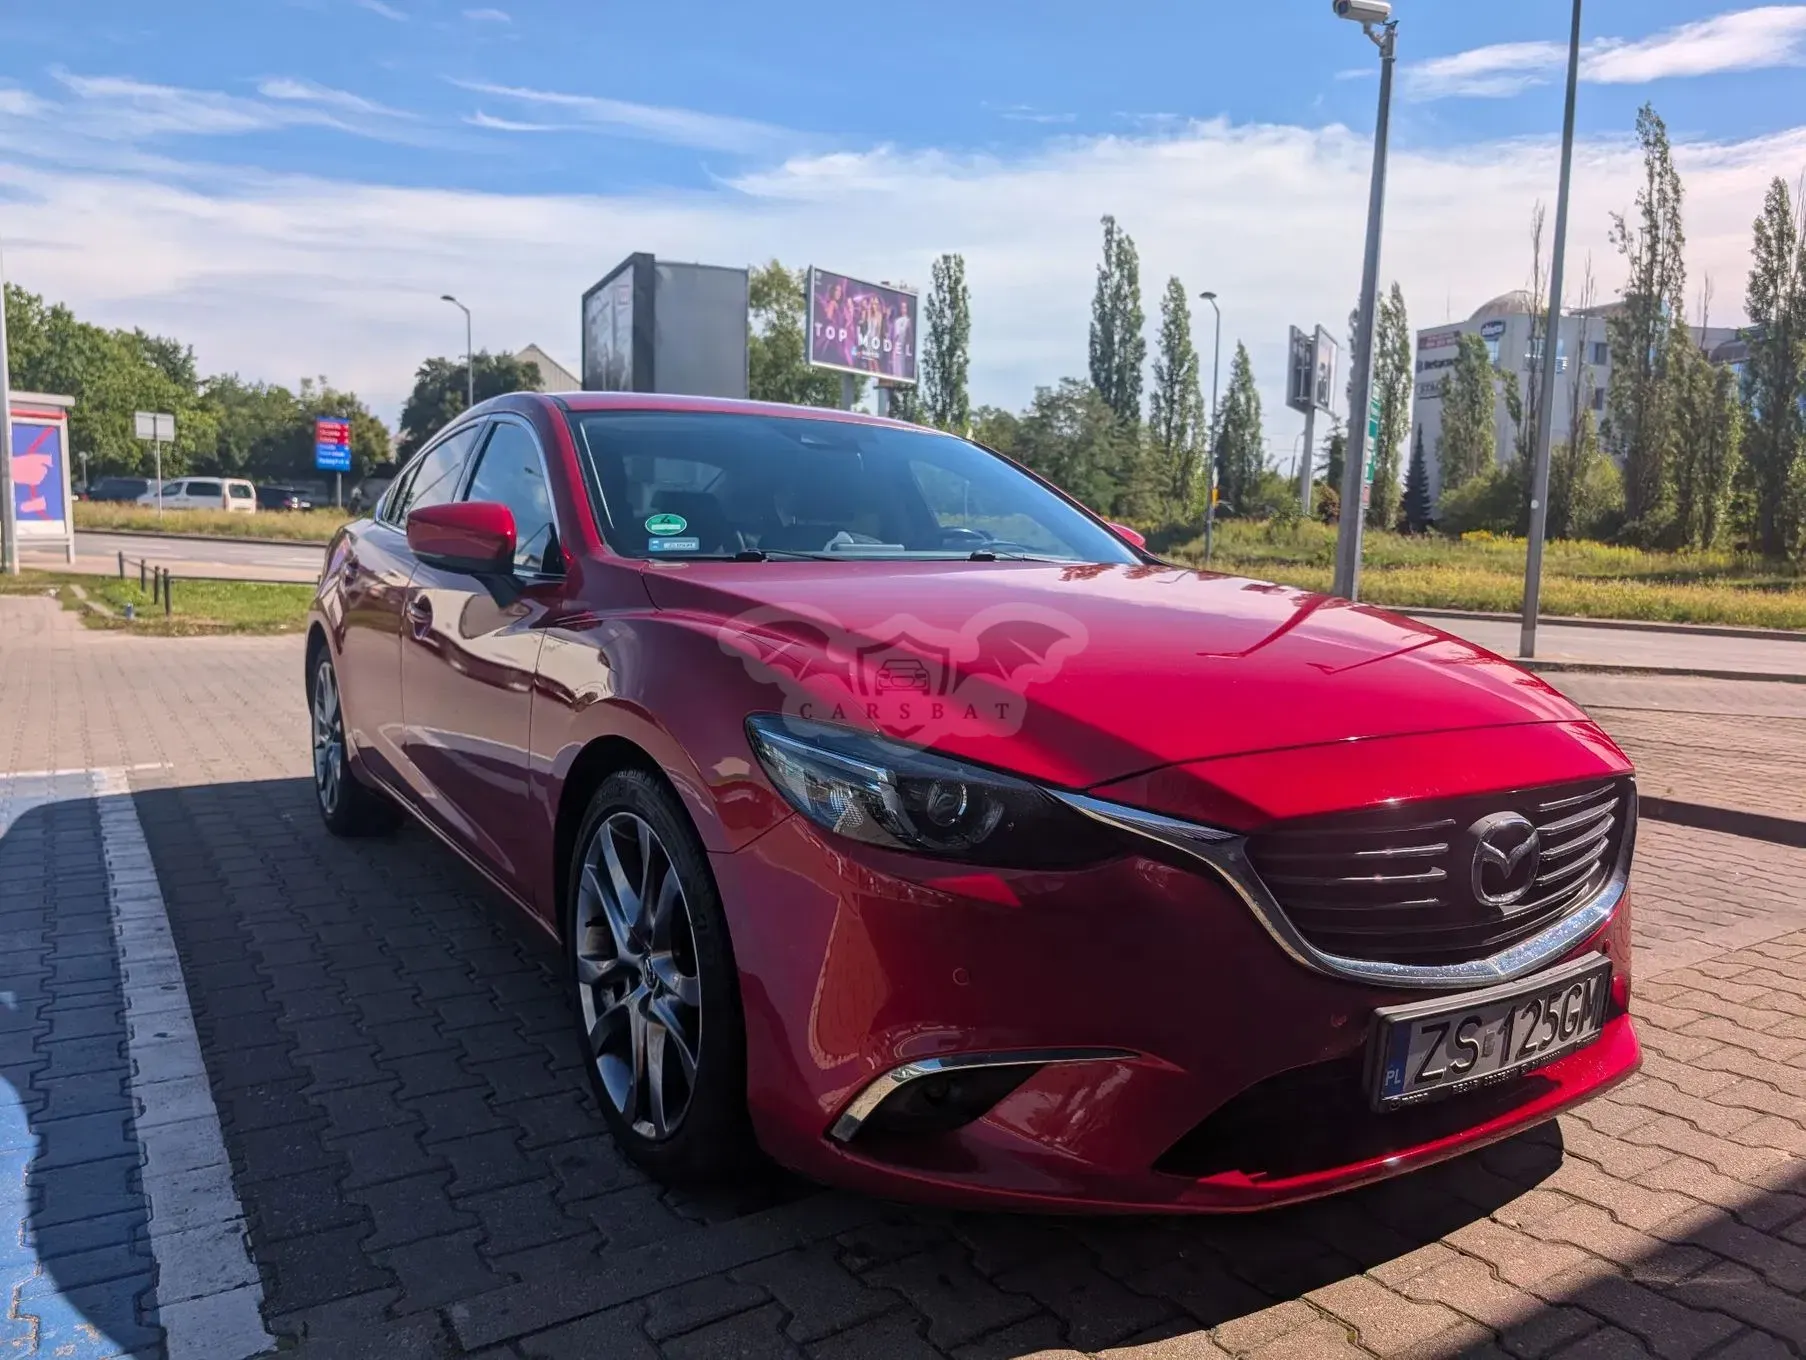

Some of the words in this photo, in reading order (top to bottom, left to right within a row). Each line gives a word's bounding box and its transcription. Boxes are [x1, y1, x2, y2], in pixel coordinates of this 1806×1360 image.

[815, 323, 848, 342] TOP
[857, 326, 912, 357] MODEL
[1414, 1015, 1483, 1085] ZS
[1498, 973, 1604, 1068] 125GM
[1384, 1068, 1402, 1086] PL
